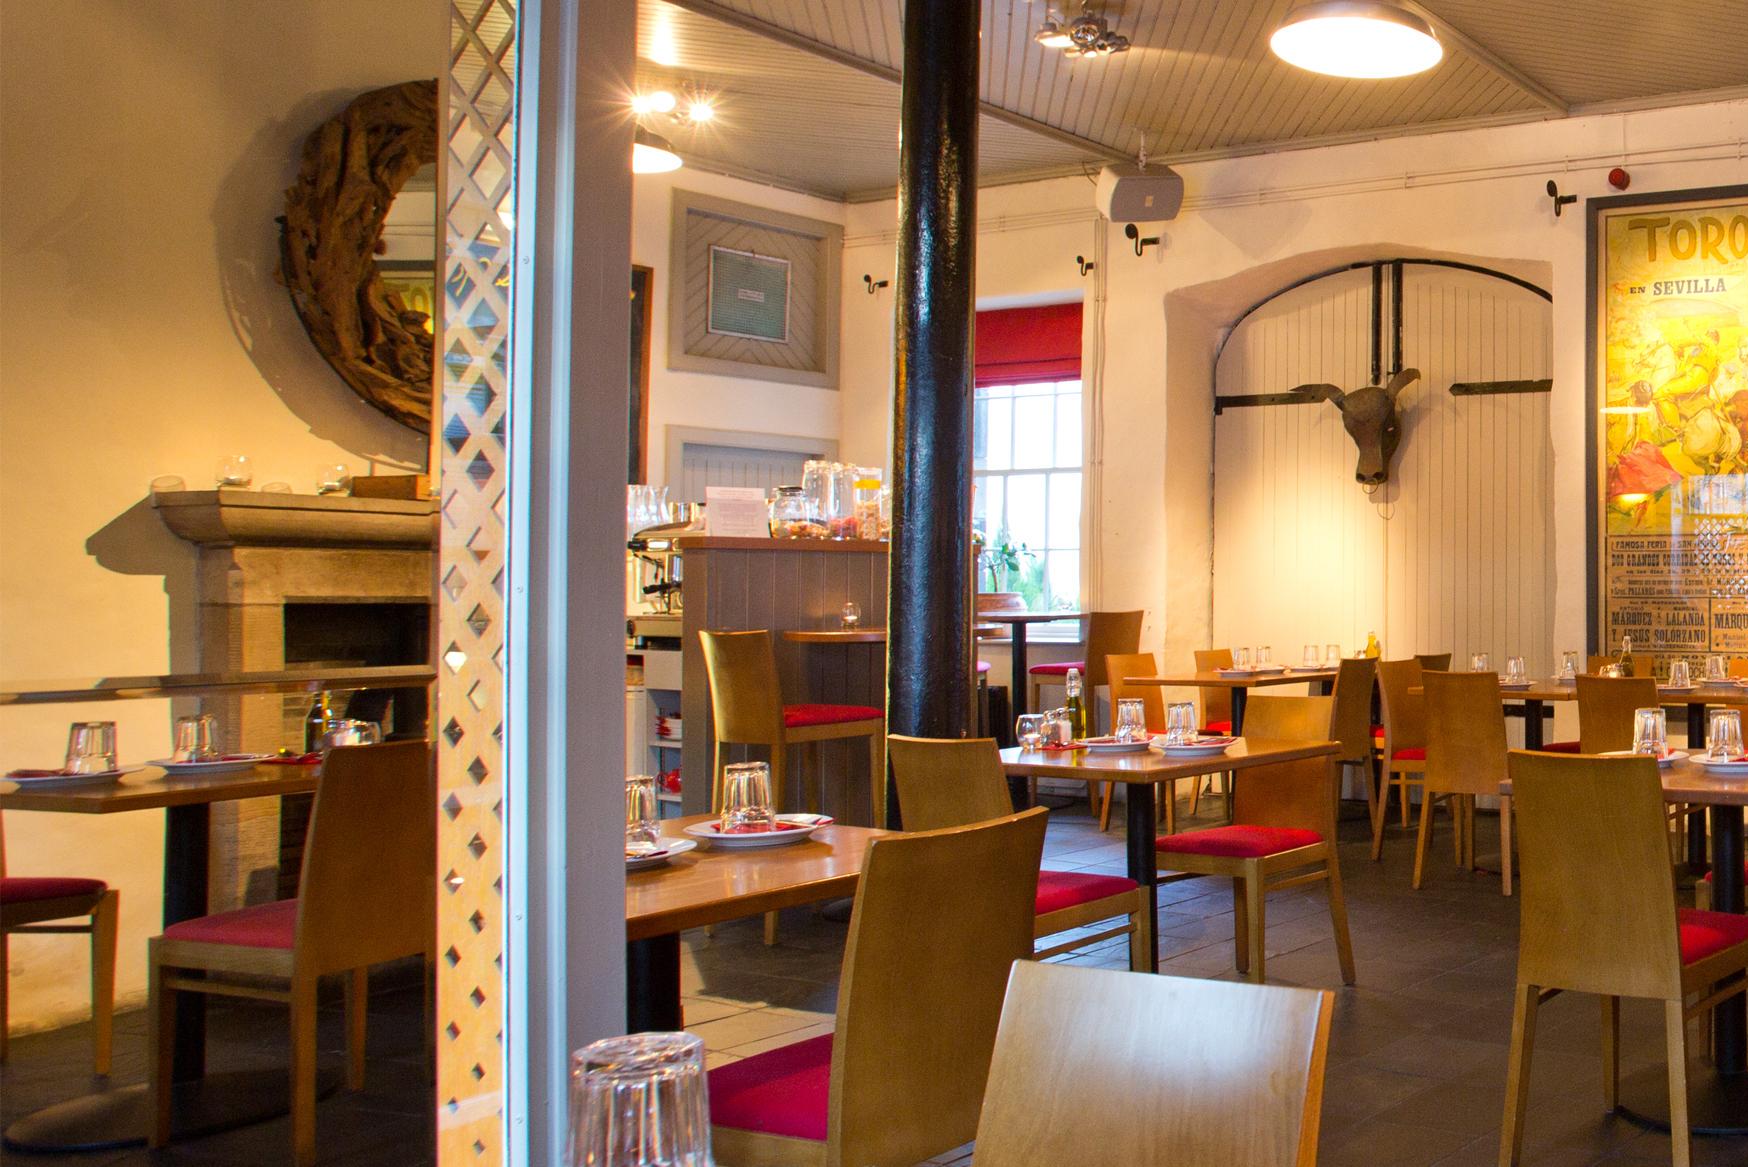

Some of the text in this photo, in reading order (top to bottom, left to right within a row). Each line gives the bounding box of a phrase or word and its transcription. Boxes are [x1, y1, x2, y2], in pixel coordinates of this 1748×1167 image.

[1629, 277, 1727, 296] EN SEVILLA
[1615, 541, 1644, 549] FAMOSA
[1626, 553, 1660, 567] GRANDES
[1666, 612, 1705, 626] LALANDA
